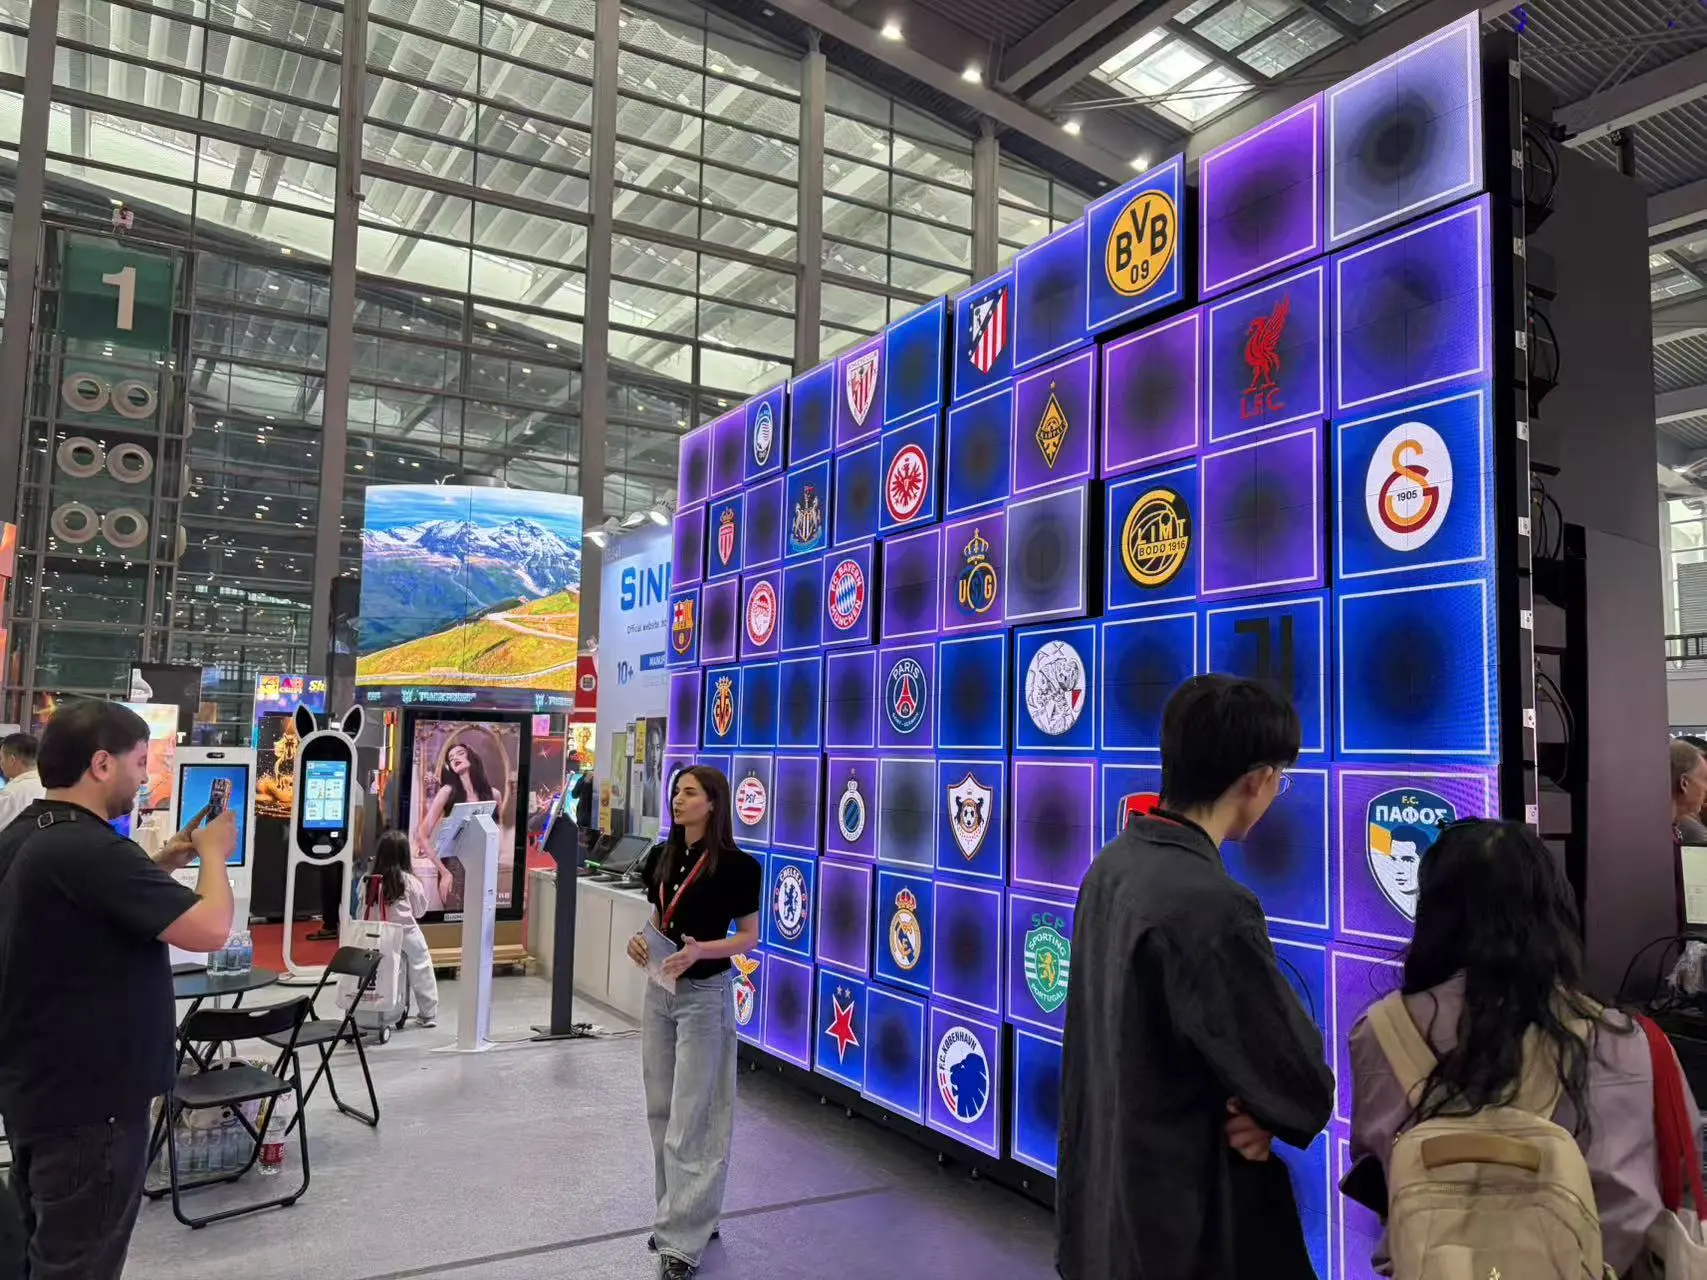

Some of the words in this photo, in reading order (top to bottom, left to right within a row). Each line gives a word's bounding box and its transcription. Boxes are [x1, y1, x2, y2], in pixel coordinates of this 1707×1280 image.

[1115, 201, 1169, 272] BVB
[1129, 259, 1151, 285] 09
[102, 266, 136, 331] 1
[1240, 388, 1284, 421] LFC
[1396, 489, 1418, 502] 1905
[1138, 542, 1167, 558] BODØ
[1167, 540, 1187, 553] 1916
[838, 563, 862, 587] BAYERN
[616, 660, 634, 687] 10+
[892, 661, 921, 681] PARIS
[1401, 795, 1420, 805] F.C.
[1375, 805, 1448, 825] ΠΑΦΟΣ
[779, 868, 803, 886] CHELSEA
[1031, 911, 1066, 931] SCP
[1028, 932, 1067, 957] SPORTING
[1030, 983, 1065, 1003] PORTUGAL
[941, 1031, 977, 1053] KØBENHAVN
